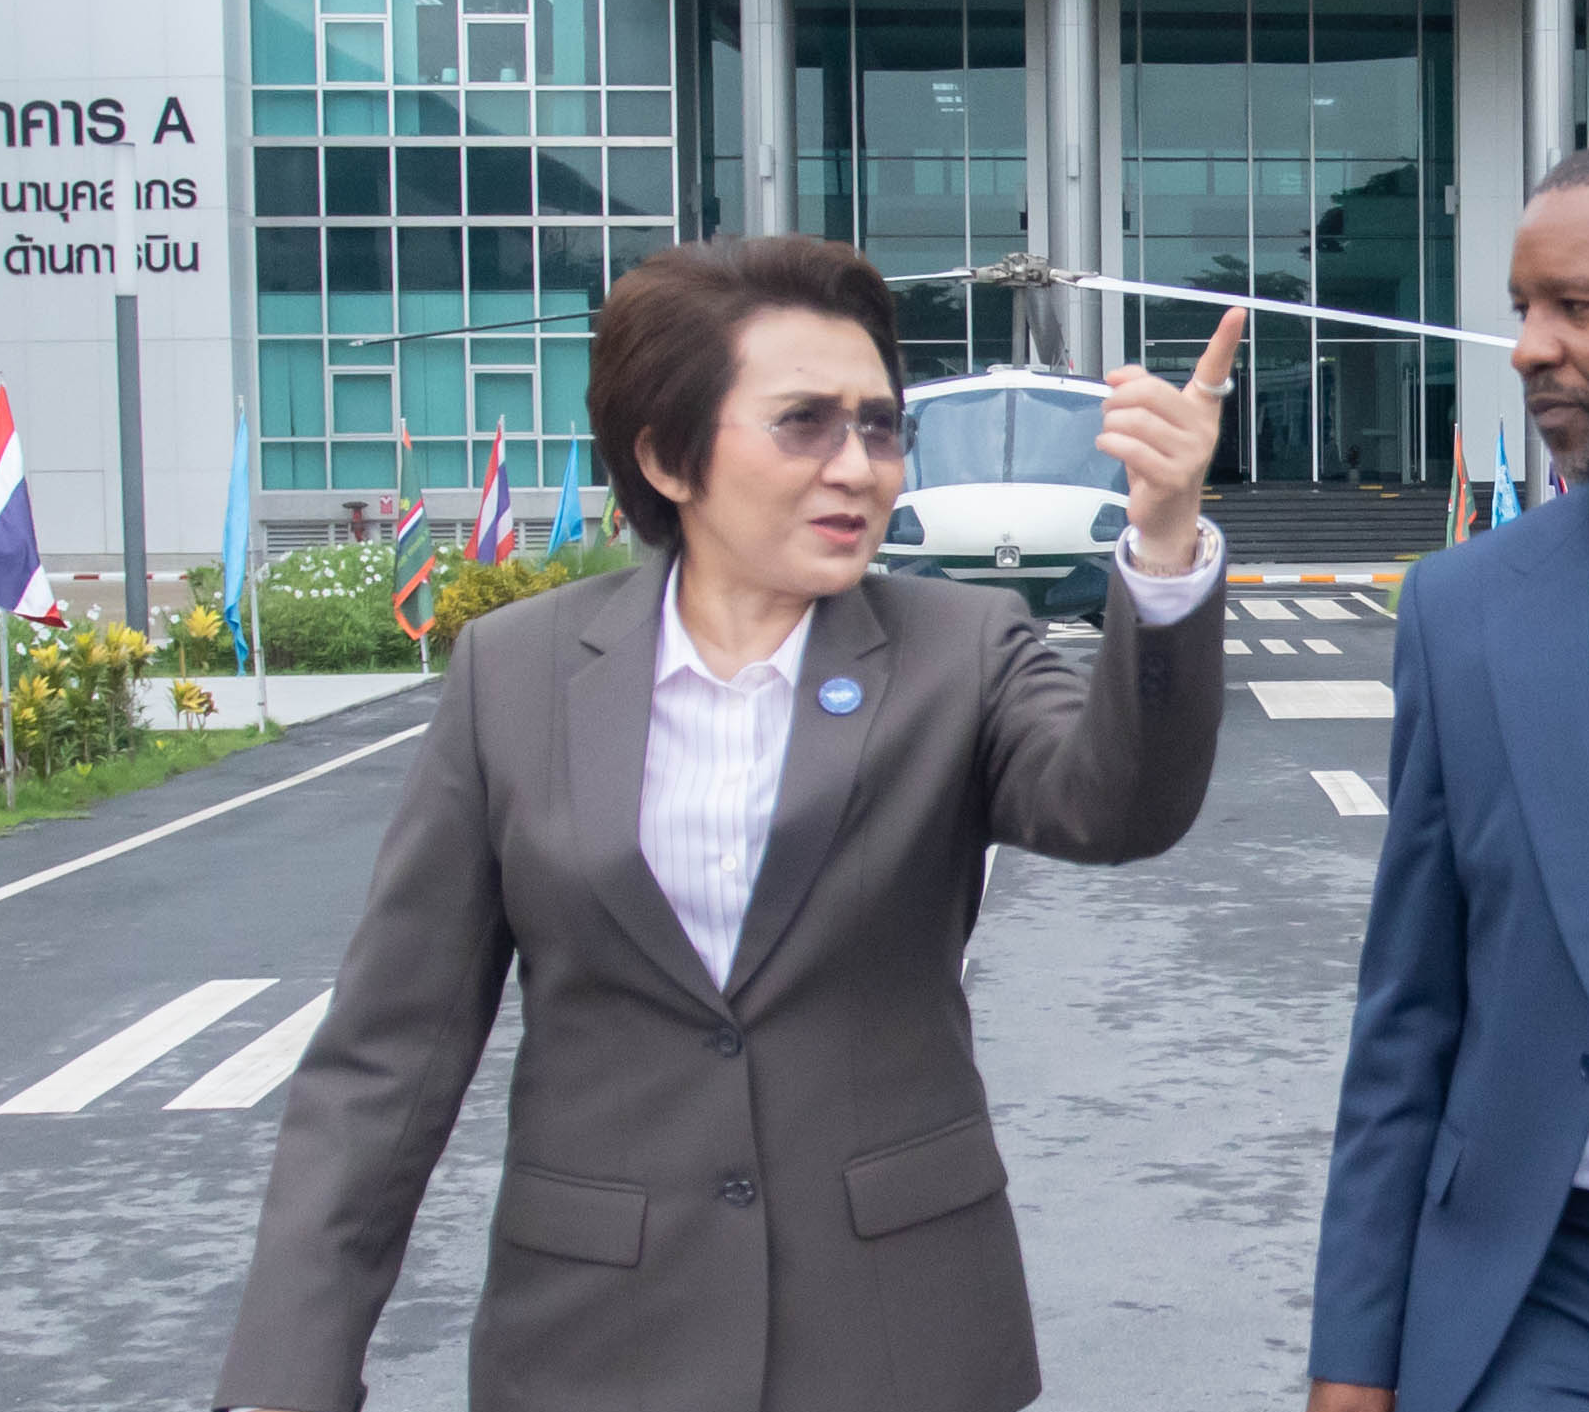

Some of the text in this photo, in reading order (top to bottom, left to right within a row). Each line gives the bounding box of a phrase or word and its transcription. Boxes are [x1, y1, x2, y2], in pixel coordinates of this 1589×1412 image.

[153, 96, 195, 144] A
[3, 234, 199, 275] ด้านกาบิน
